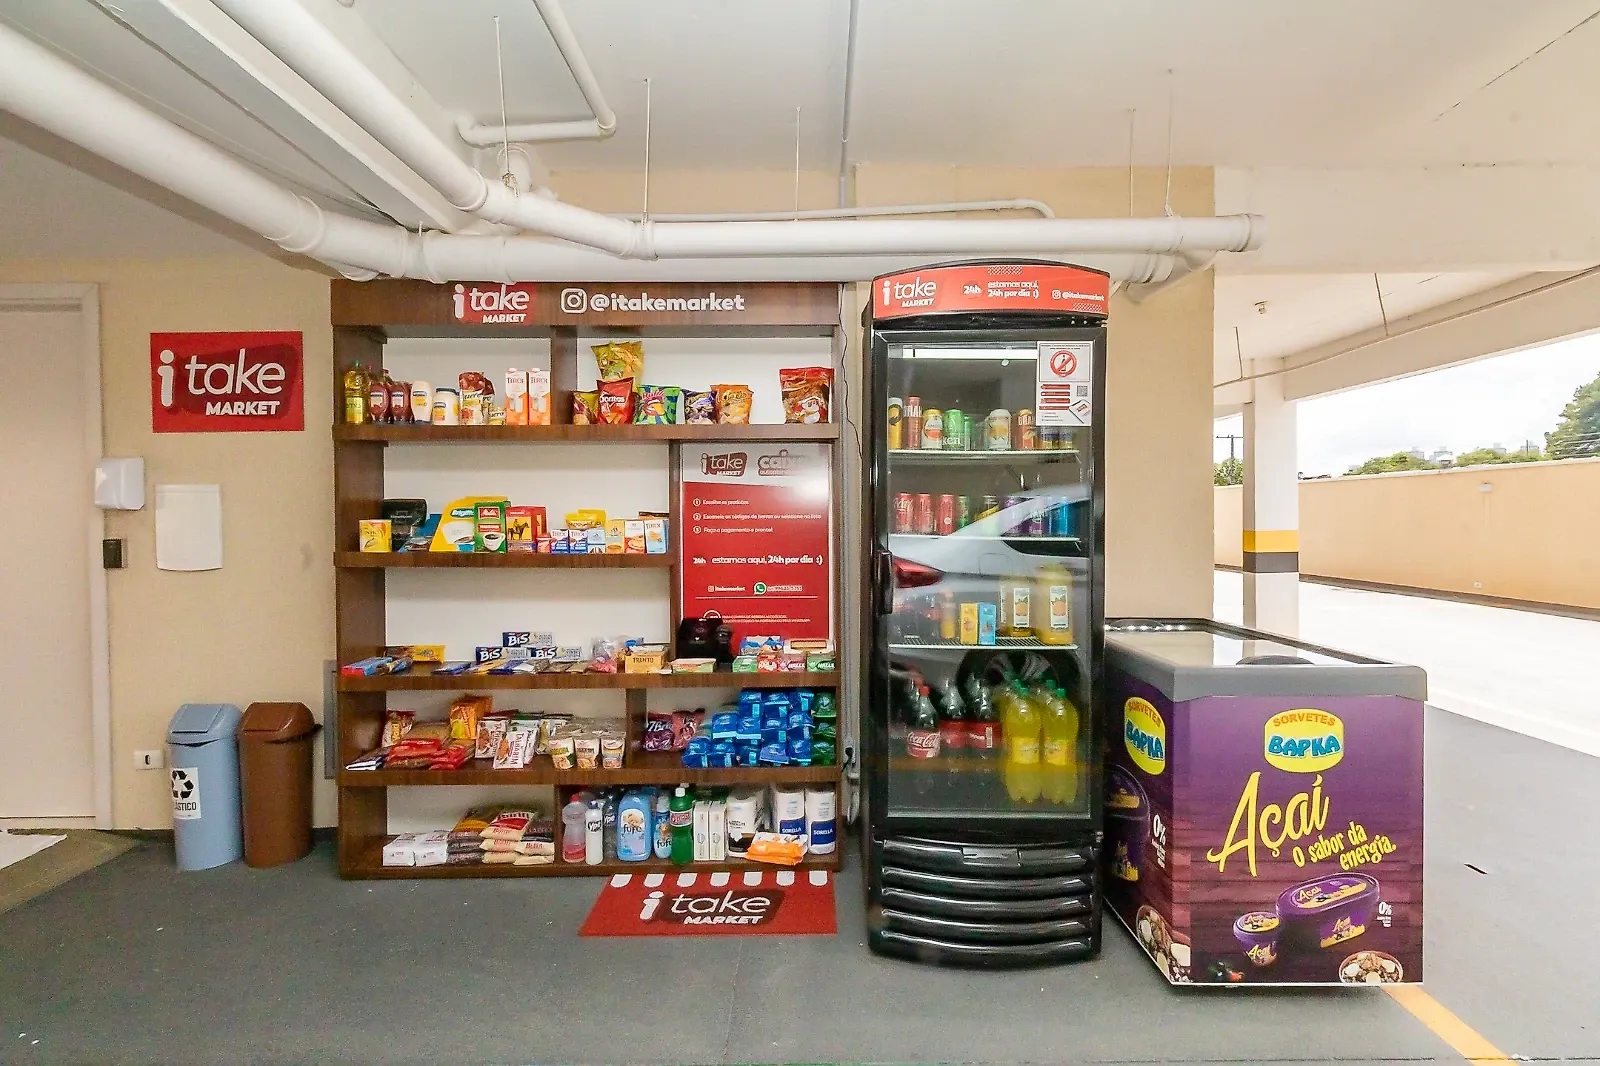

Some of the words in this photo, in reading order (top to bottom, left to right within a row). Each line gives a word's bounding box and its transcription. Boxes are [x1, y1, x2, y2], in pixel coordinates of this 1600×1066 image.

[882, 280, 890, 305] i
[894, 276, 936, 298] take
[963, 284, 981, 295] 24h
[987, 281, 1021, 290] estamos
[987, 289, 1003, 298] 24h
[1004, 291, 1017, 299] por
[453, 284, 465, 319] i
[470, 284, 530, 312] take
[590, 292, 746, 312] @itakemarket
[901, 298, 934, 308] MARKET
[1062, 291, 1104, 301] @itakemarket
[482, 313, 527, 324] MARKET
[157, 349, 175, 407] i
[185, 348, 286, 395] take
[205, 401, 280, 416] MARKET
[711, 453, 743, 469] take
[712, 556, 747, 564] estamos
[768, 555, 784, 564] 24h
[785, 557, 799, 565] por
[1128, 701, 1161, 727] SORVETES
[1273, 713, 1336, 727] SORVETES
[1126, 719, 1164, 761] BAPKA
[1267, 734, 1341, 757] BAPKA
[1207, 771, 1330, 877] Açaí
[1308, 832, 1345, 864] sabor
[1347, 821, 1368, 846] da
[1339, 834, 1397, 871] energia.
[640, 891, 664, 920] i
[671, 890, 771, 914] take
[683, 915, 763, 925] MARKET
